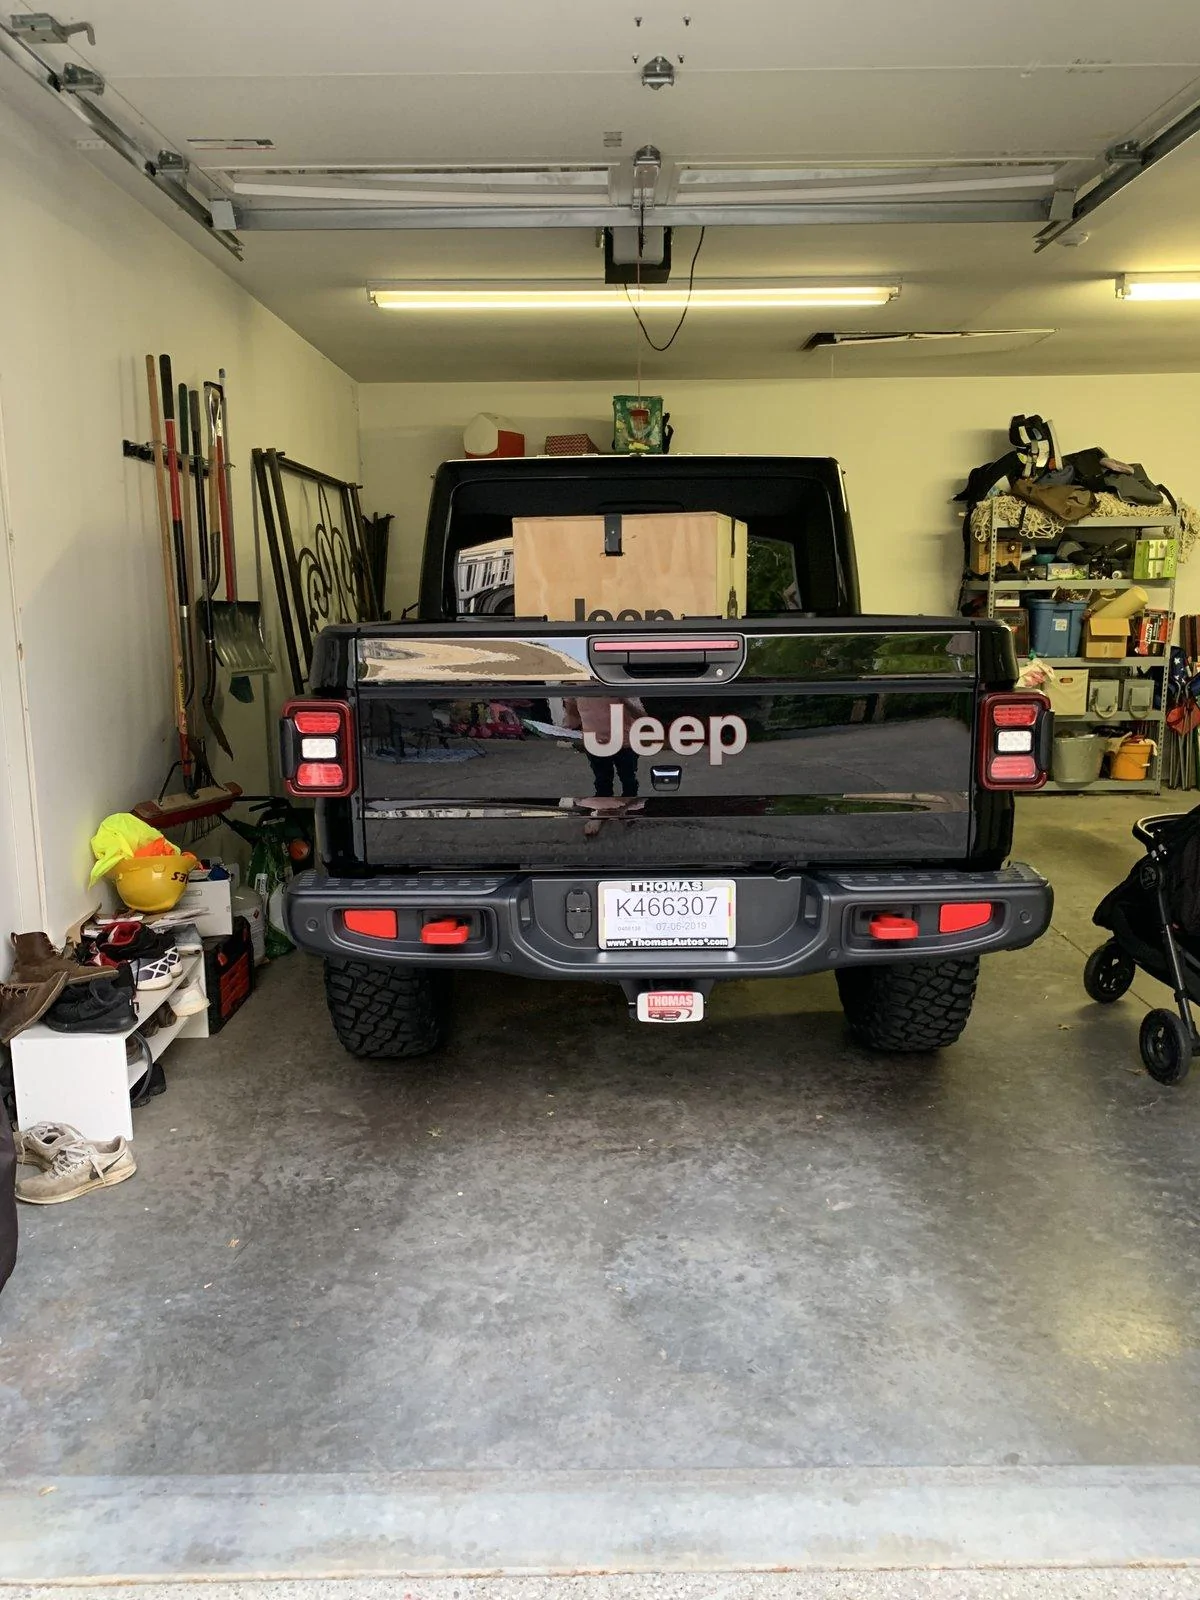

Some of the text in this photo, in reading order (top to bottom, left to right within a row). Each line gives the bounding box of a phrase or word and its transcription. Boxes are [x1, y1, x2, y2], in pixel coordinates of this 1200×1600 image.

[583, 703, 748, 766] Jeep
[631, 881, 703, 892] THOMAS
[616, 896, 718, 917] K466307
[648, 995, 692, 1007] THOMAS
